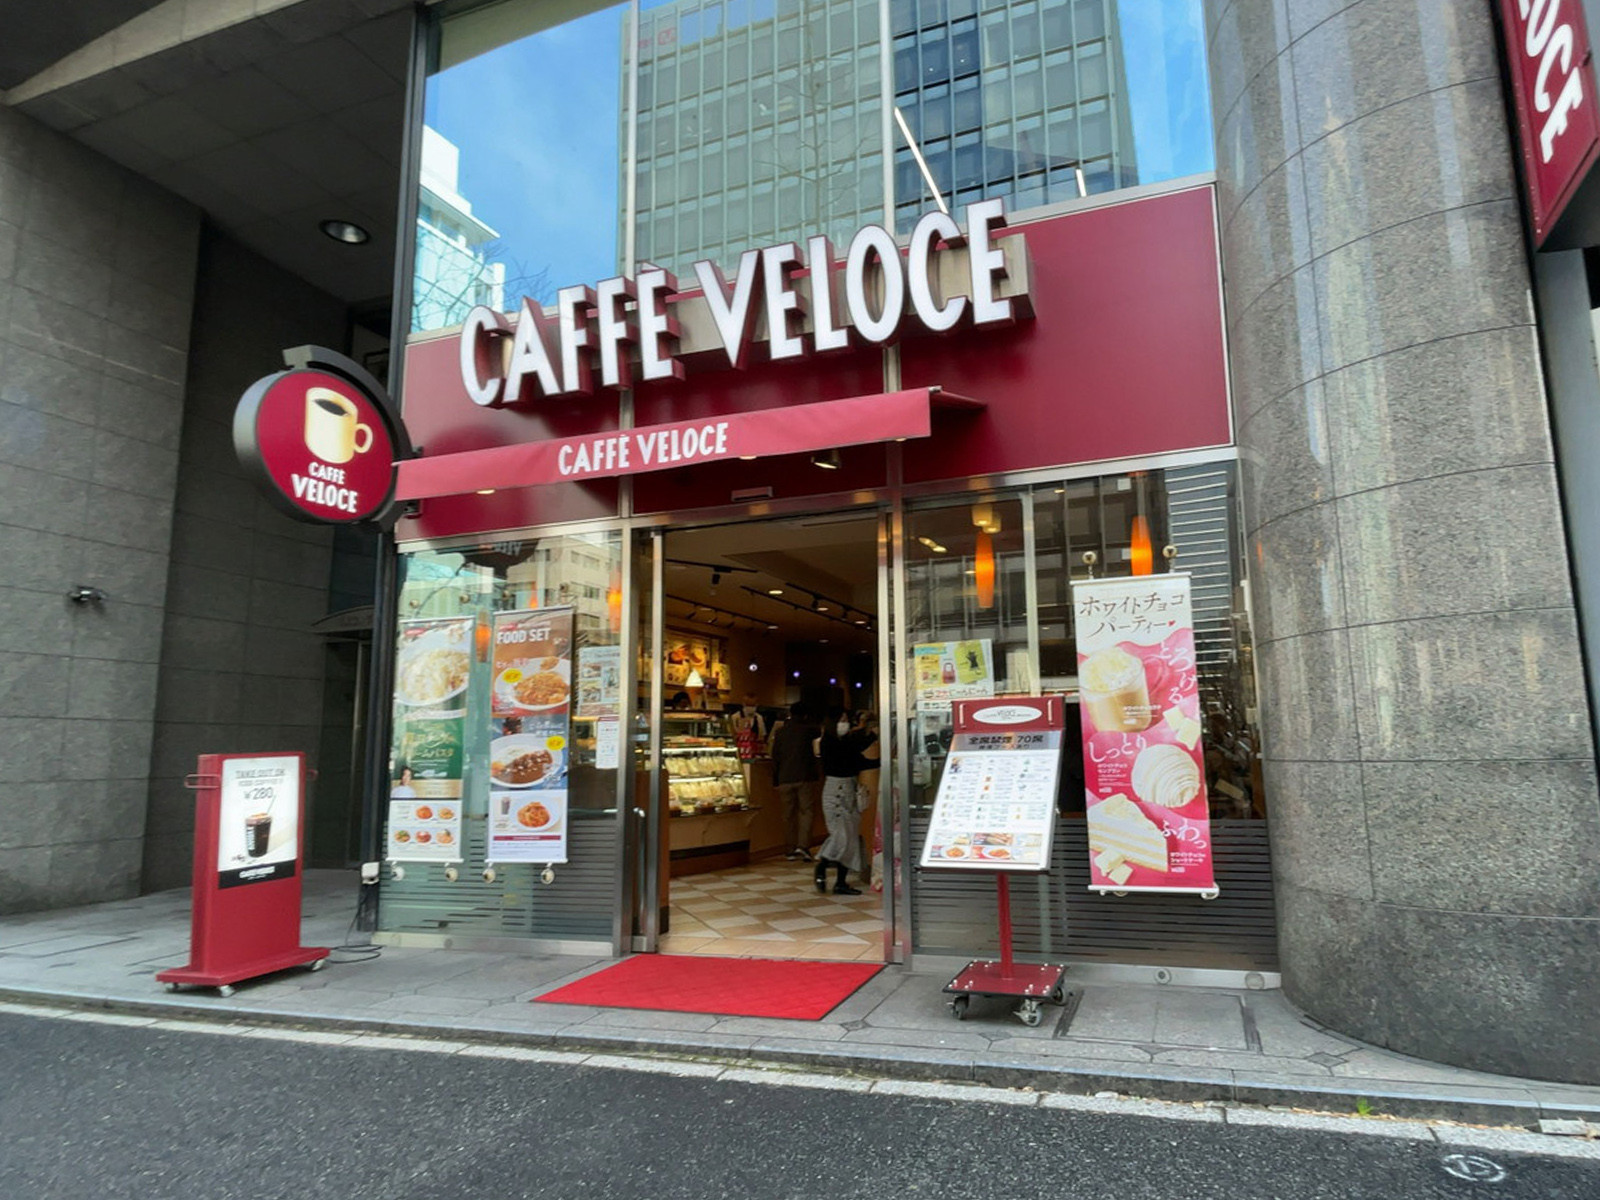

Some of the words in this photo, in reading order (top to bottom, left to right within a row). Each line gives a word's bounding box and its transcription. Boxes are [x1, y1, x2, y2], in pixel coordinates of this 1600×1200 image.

[695, 199, 1014, 369] VELOCE
[637, 422, 728, 465] VELOCE
[291, 473, 358, 513] VELOCE
[1080, 592, 1184, 616] ホワイトチョコ
[496, 630, 527, 645] FOOD
[528, 627, 552, 642] SET
[1087, 616, 1166, 638] パーティー
[1089, 732, 1147, 762] しっとり
